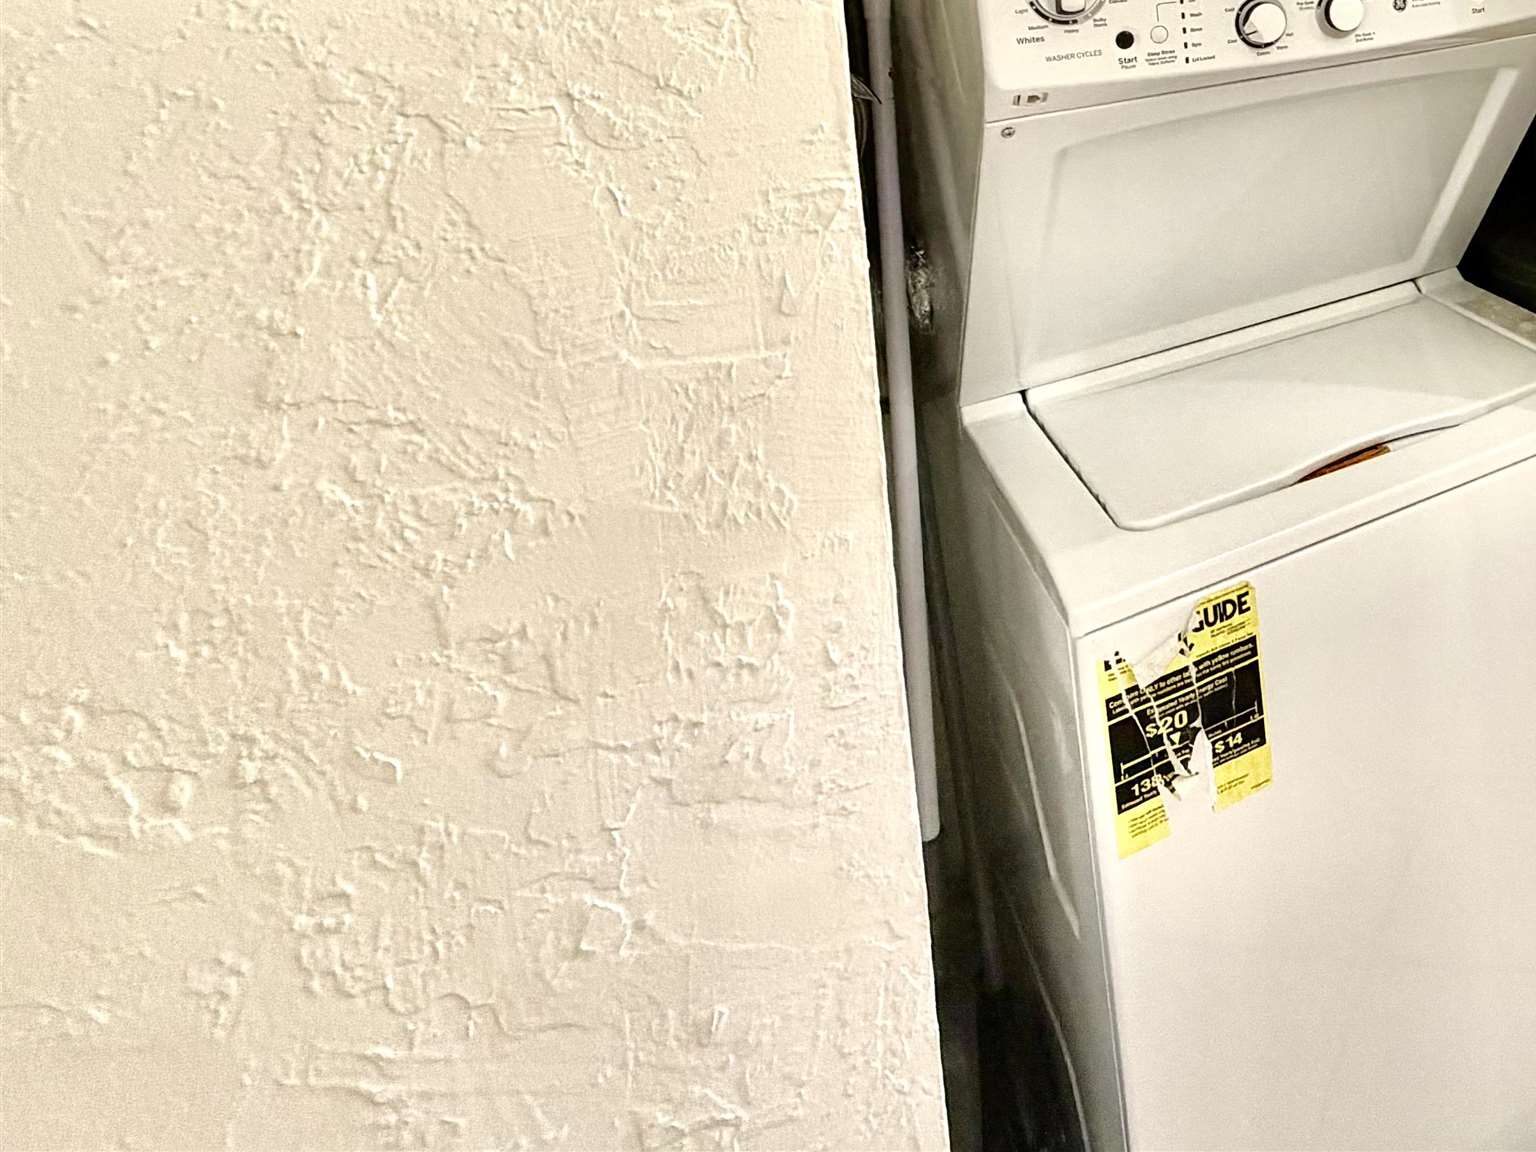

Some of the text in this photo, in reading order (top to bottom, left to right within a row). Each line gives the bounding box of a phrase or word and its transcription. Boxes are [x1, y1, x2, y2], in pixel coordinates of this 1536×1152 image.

[1016, 34, 1046, 45] Whites
[1045, 49, 1102, 62] WASHER CYCLES
[1118, 56, 1138, 65] Start
[1145, 709, 1188, 739] $20
